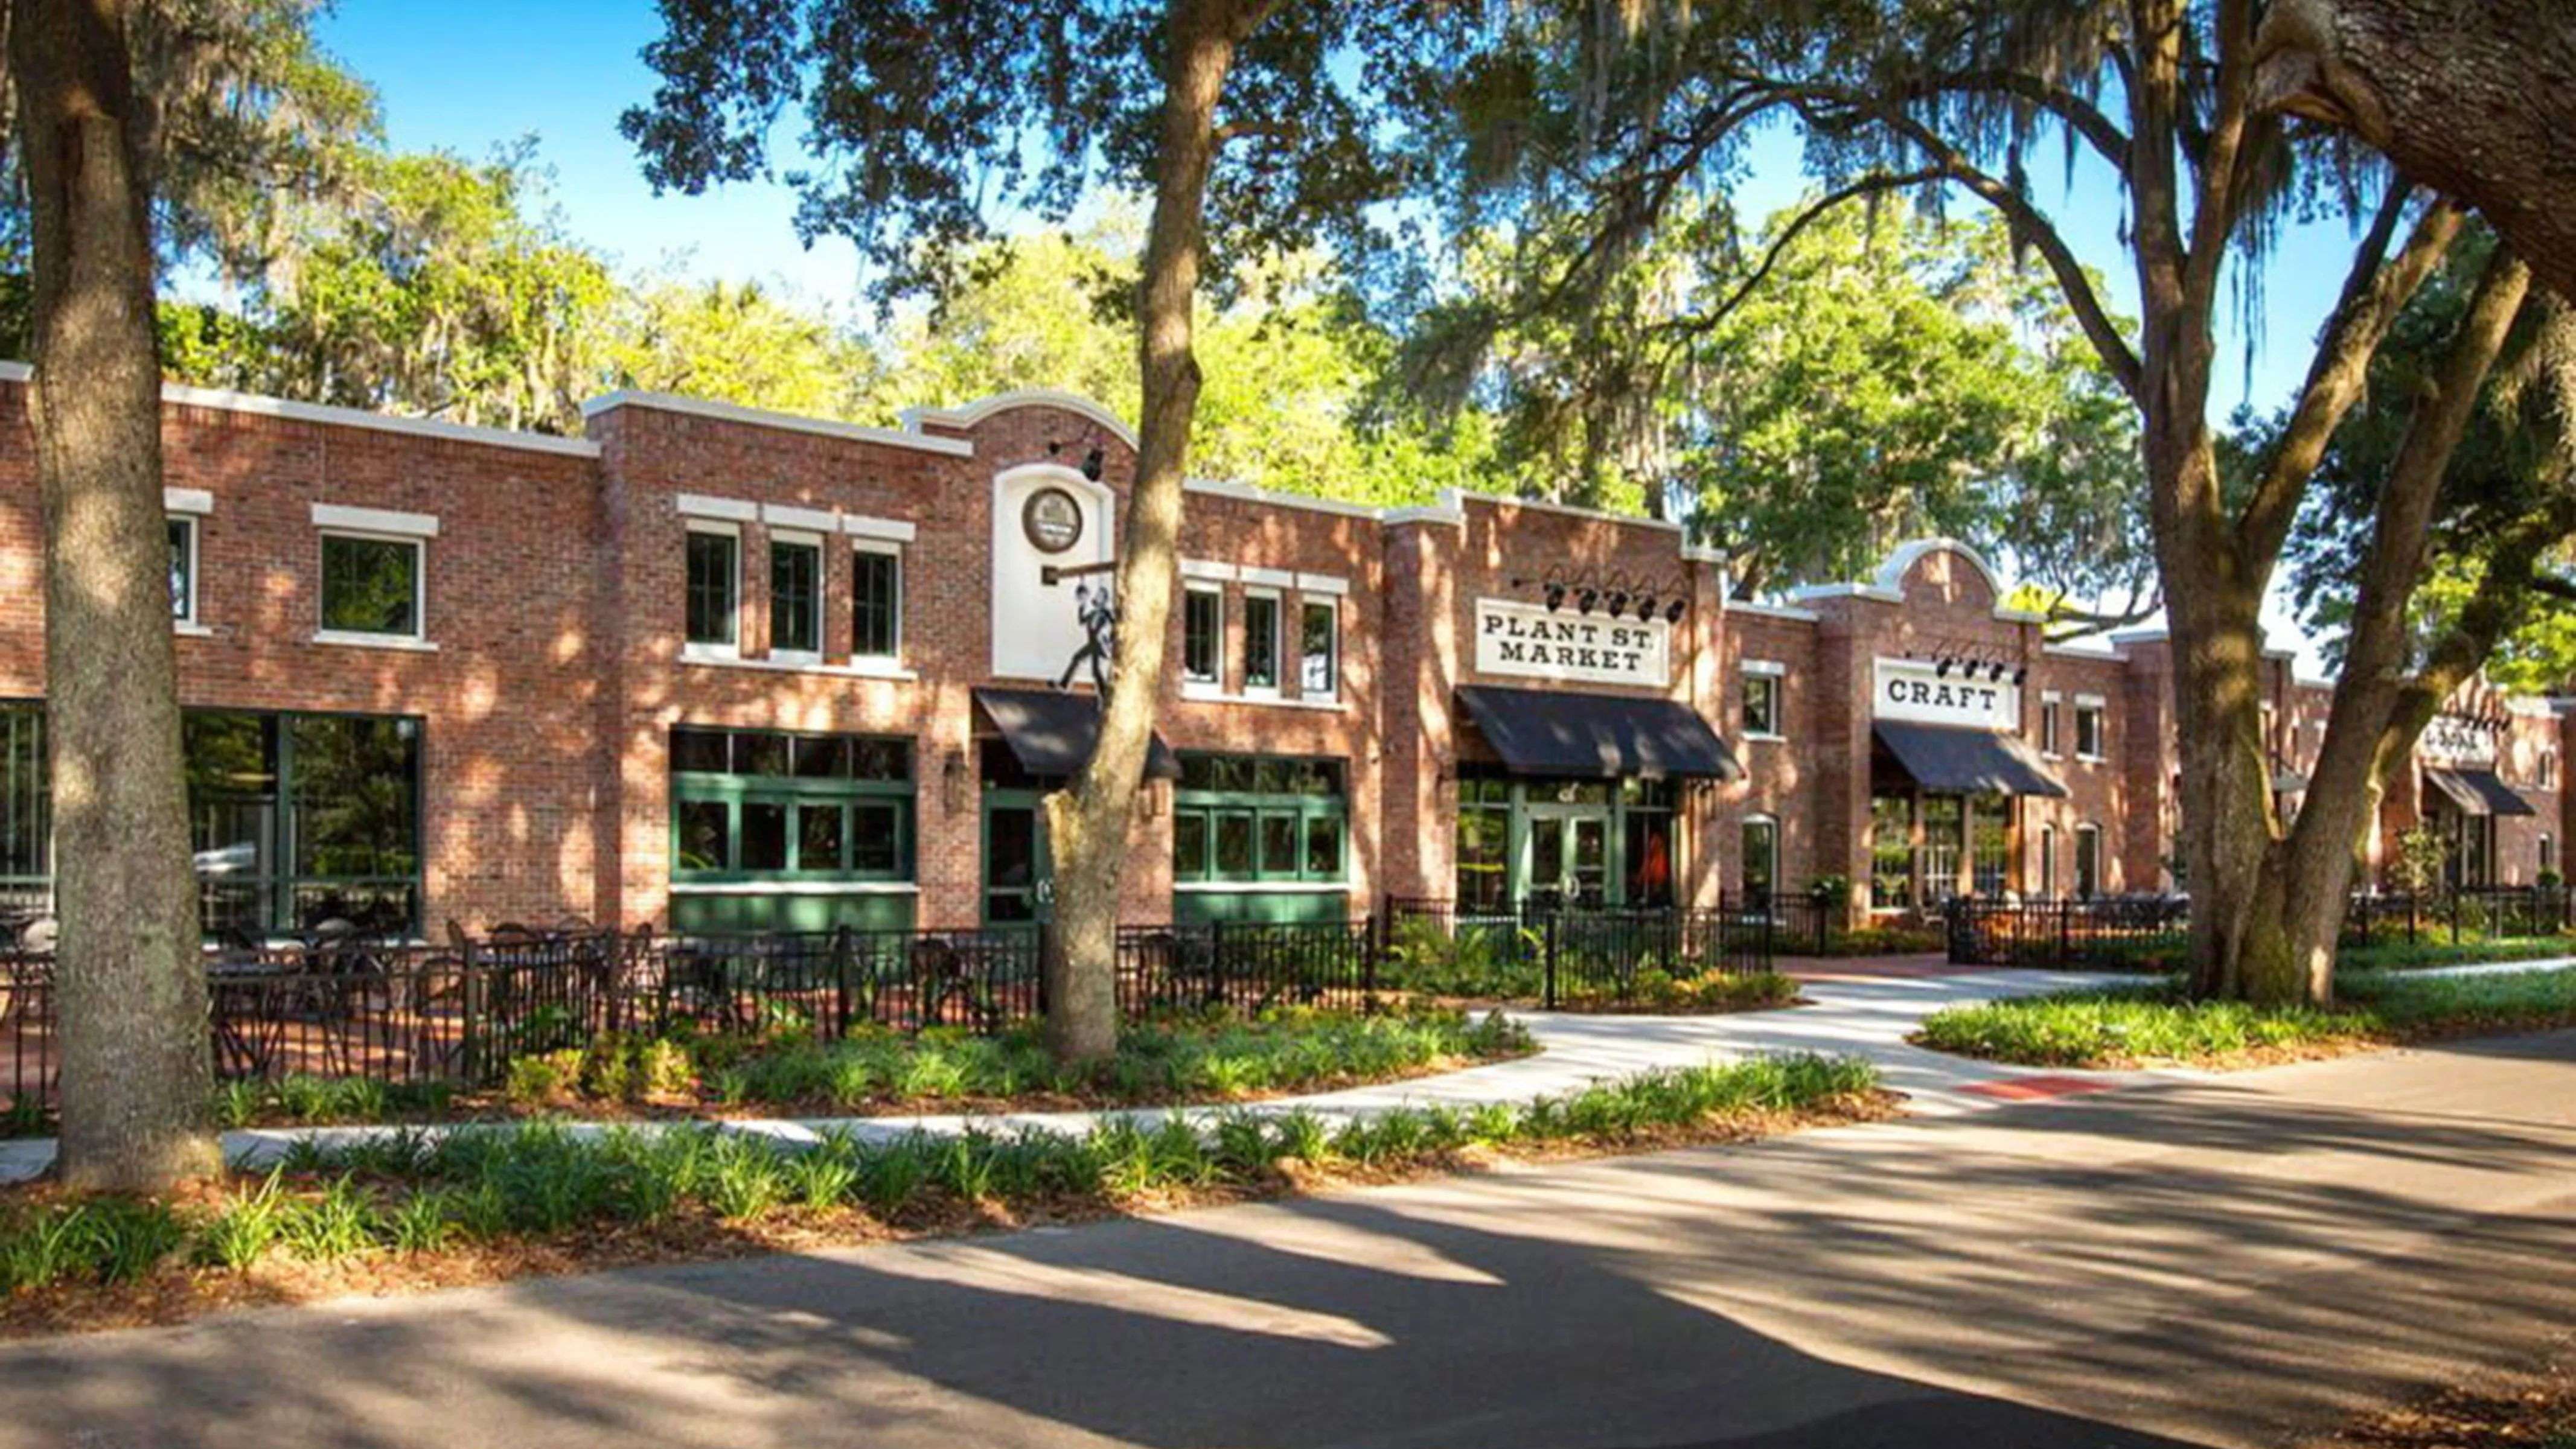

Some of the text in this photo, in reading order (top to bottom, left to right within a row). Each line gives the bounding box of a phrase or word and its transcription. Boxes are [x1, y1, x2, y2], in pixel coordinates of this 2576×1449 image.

[1485, 615, 1654, 649] PLANT ST.
[1500, 642, 1640, 670] MARKET
[1888, 680, 1996, 710] CRAFT
